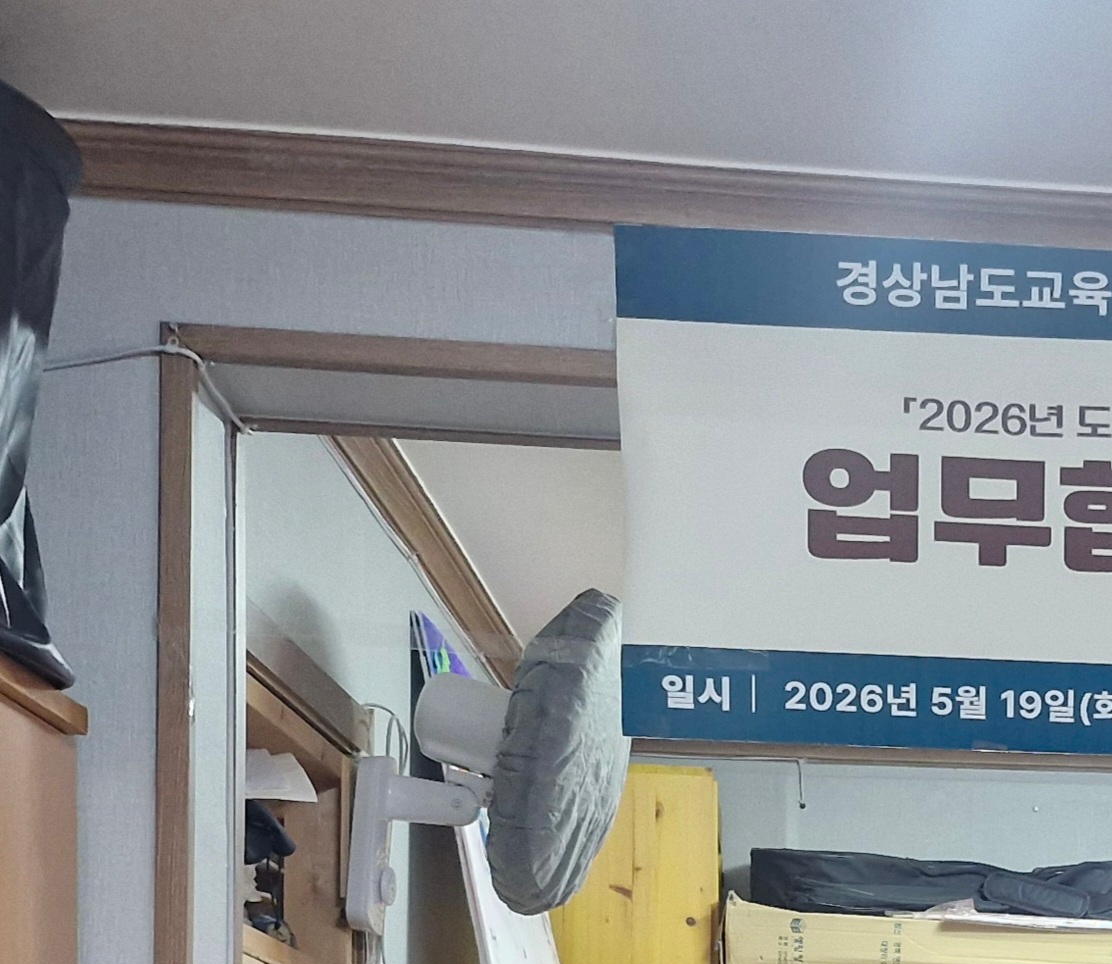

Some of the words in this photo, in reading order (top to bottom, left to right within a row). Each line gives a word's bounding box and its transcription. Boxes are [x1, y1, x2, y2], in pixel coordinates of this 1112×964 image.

[903, 396, 1065, 439] 「2026년
[661, 674, 731, 713] 일시
[784, 680, 918, 718] 2026년
[931, 686, 988, 722] 5월
